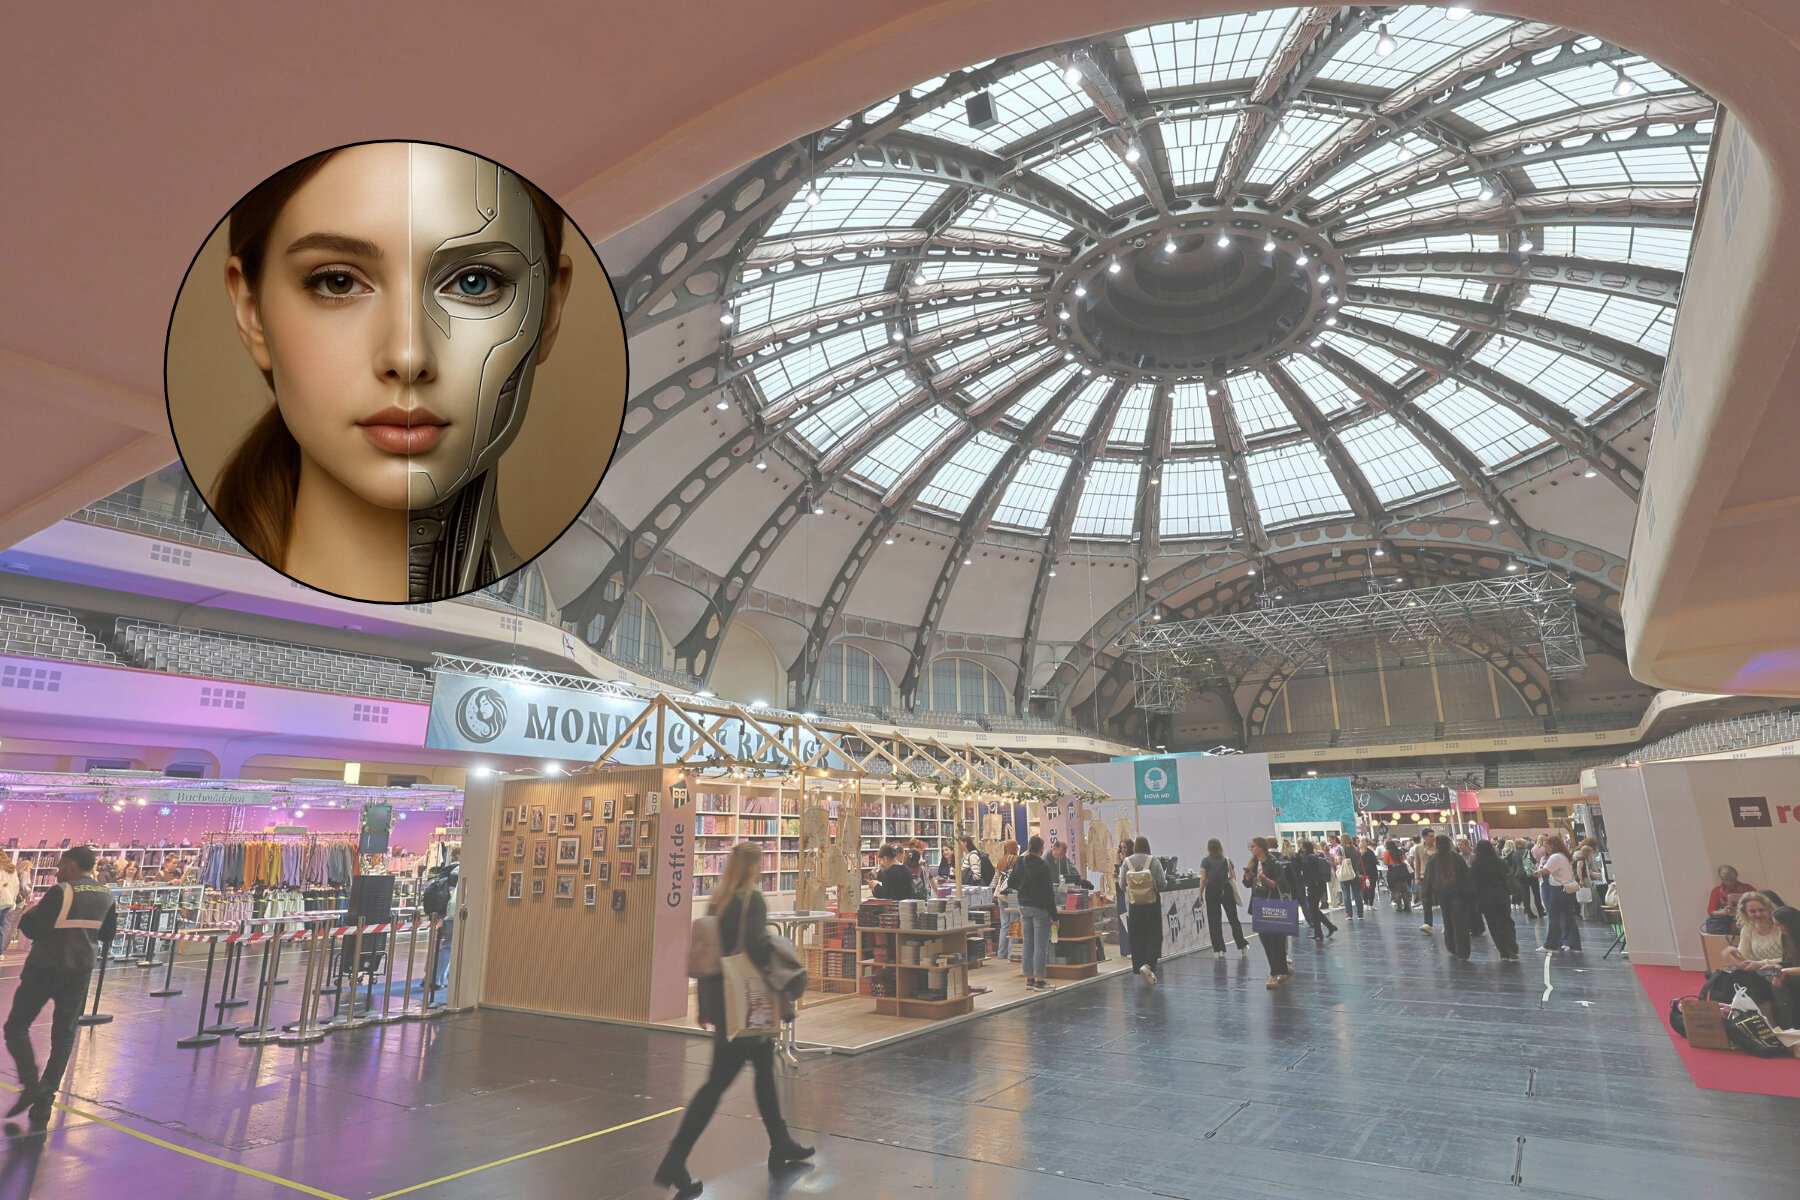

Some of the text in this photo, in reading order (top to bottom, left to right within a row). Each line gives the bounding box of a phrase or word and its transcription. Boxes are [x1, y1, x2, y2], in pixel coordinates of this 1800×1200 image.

[523, 703, 728, 758] MONDLCHT
[177, 792, 245, 802] Buchmädchen
[1395, 793, 1446, 803] VAJOSU
[666, 823, 686, 908] Graff.de
